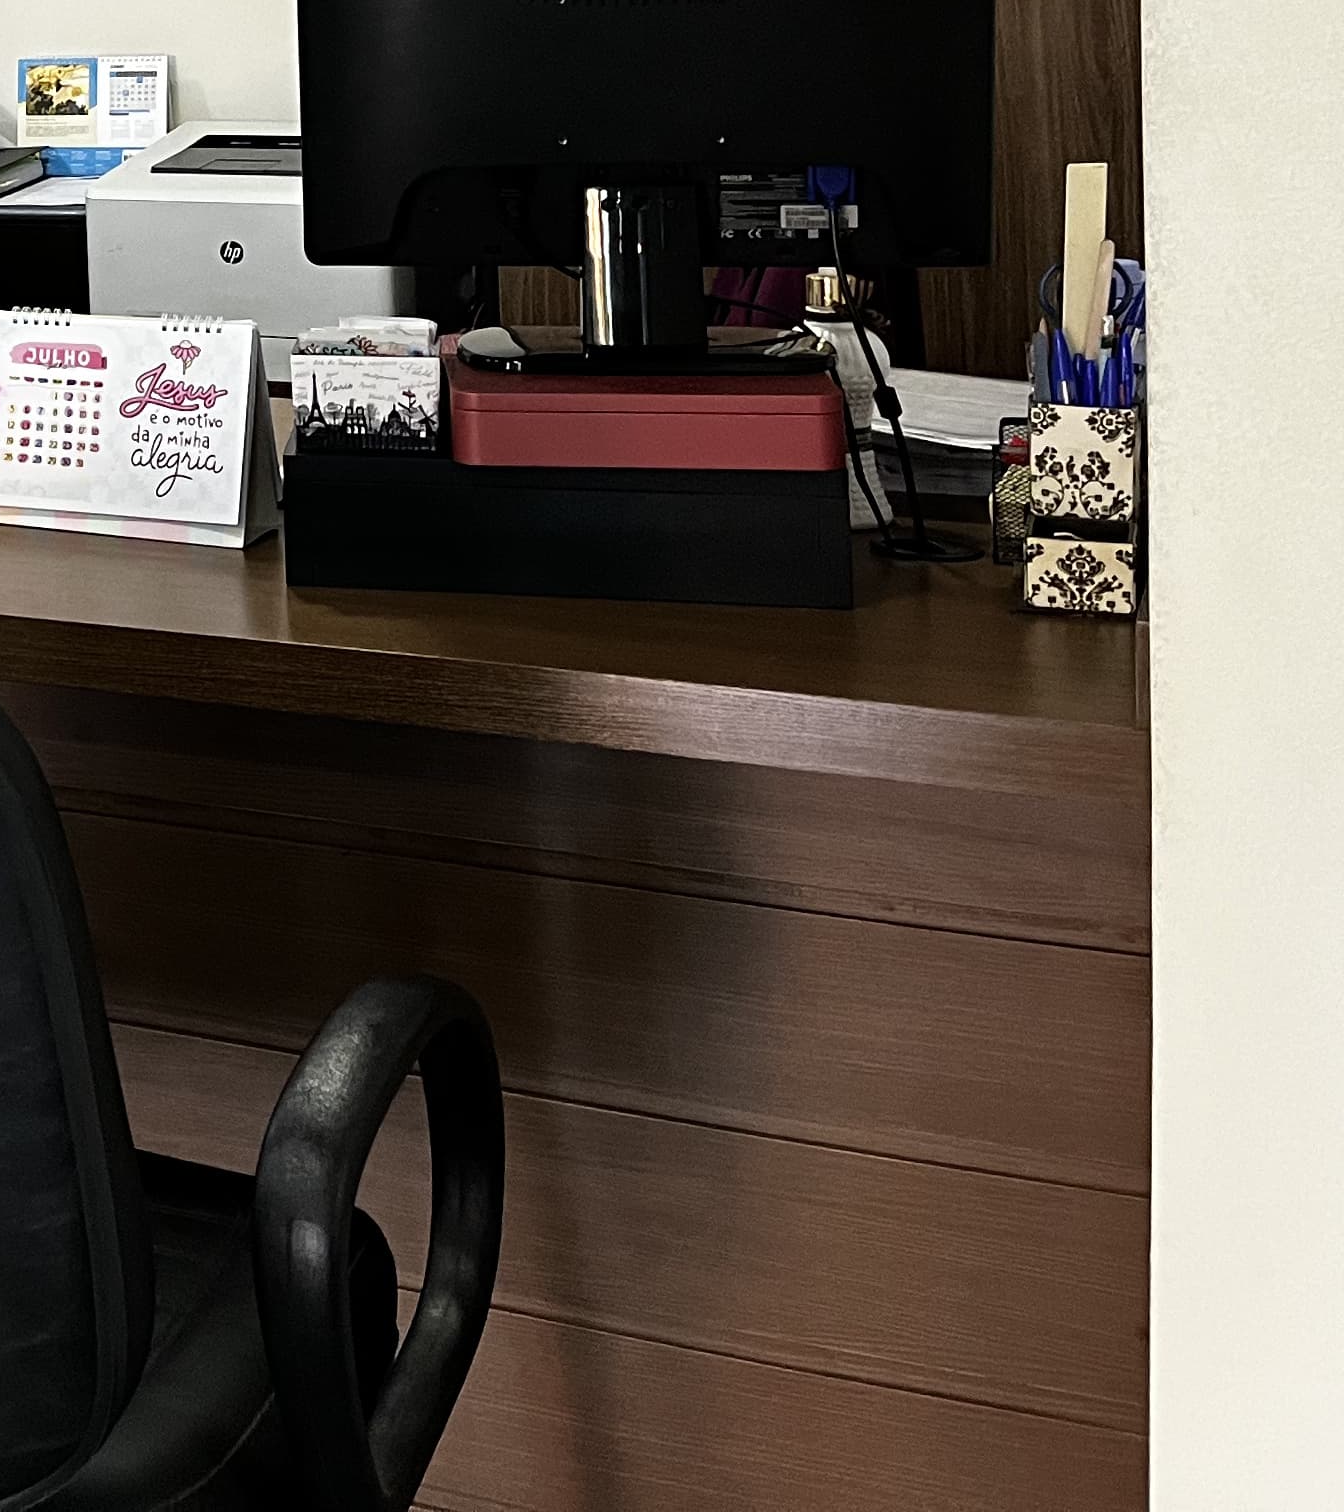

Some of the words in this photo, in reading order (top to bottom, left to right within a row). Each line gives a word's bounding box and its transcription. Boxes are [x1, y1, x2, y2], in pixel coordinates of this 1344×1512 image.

[221, 241, 242, 263] hp
[25, 346, 91, 367] JULHO
[119, 363, 228, 418] Jesus
[162, 415, 170, 424] o
[131, 424, 150, 443] da
[131, 433, 223, 498] alegria
